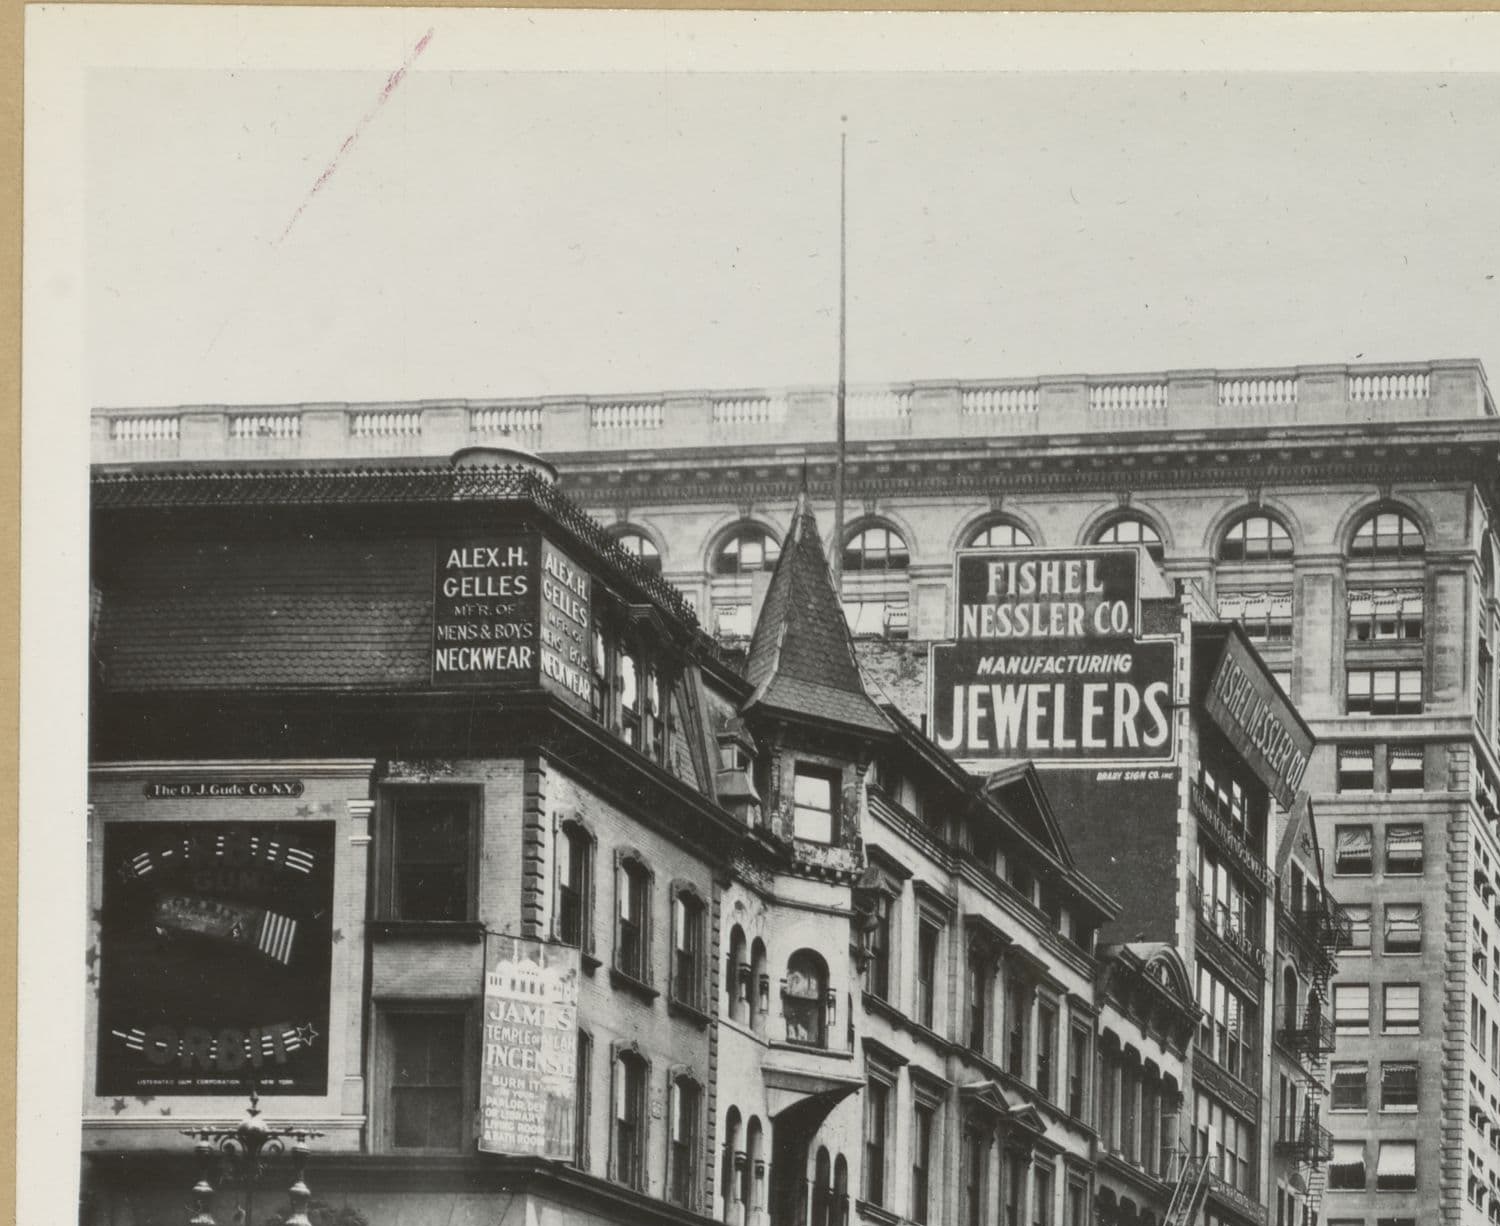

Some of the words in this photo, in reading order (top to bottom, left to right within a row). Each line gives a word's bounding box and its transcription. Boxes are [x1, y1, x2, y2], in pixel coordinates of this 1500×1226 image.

[443, 575, 528, 598] GELLES
[986, 558, 1105, 597] FISHEL
[543, 579, 588, 629] GELLES
[962, 601, 1086, 639] NESSLER
[1093, 599, 1134, 635] CO.
[436, 645, 531, 672] NECKWEAR
[541, 647, 591, 703] NECKWEAR
[976, 653, 1133, 677] MANUFACTURING
[936, 681, 1170, 752] JEWELERS
[1215, 652, 1255, 729] FISHEL
[1245, 696, 1294, 778] NESSLER
[155, 783, 179, 796] The
[486, 1024, 532, 1046] TEMPLE
